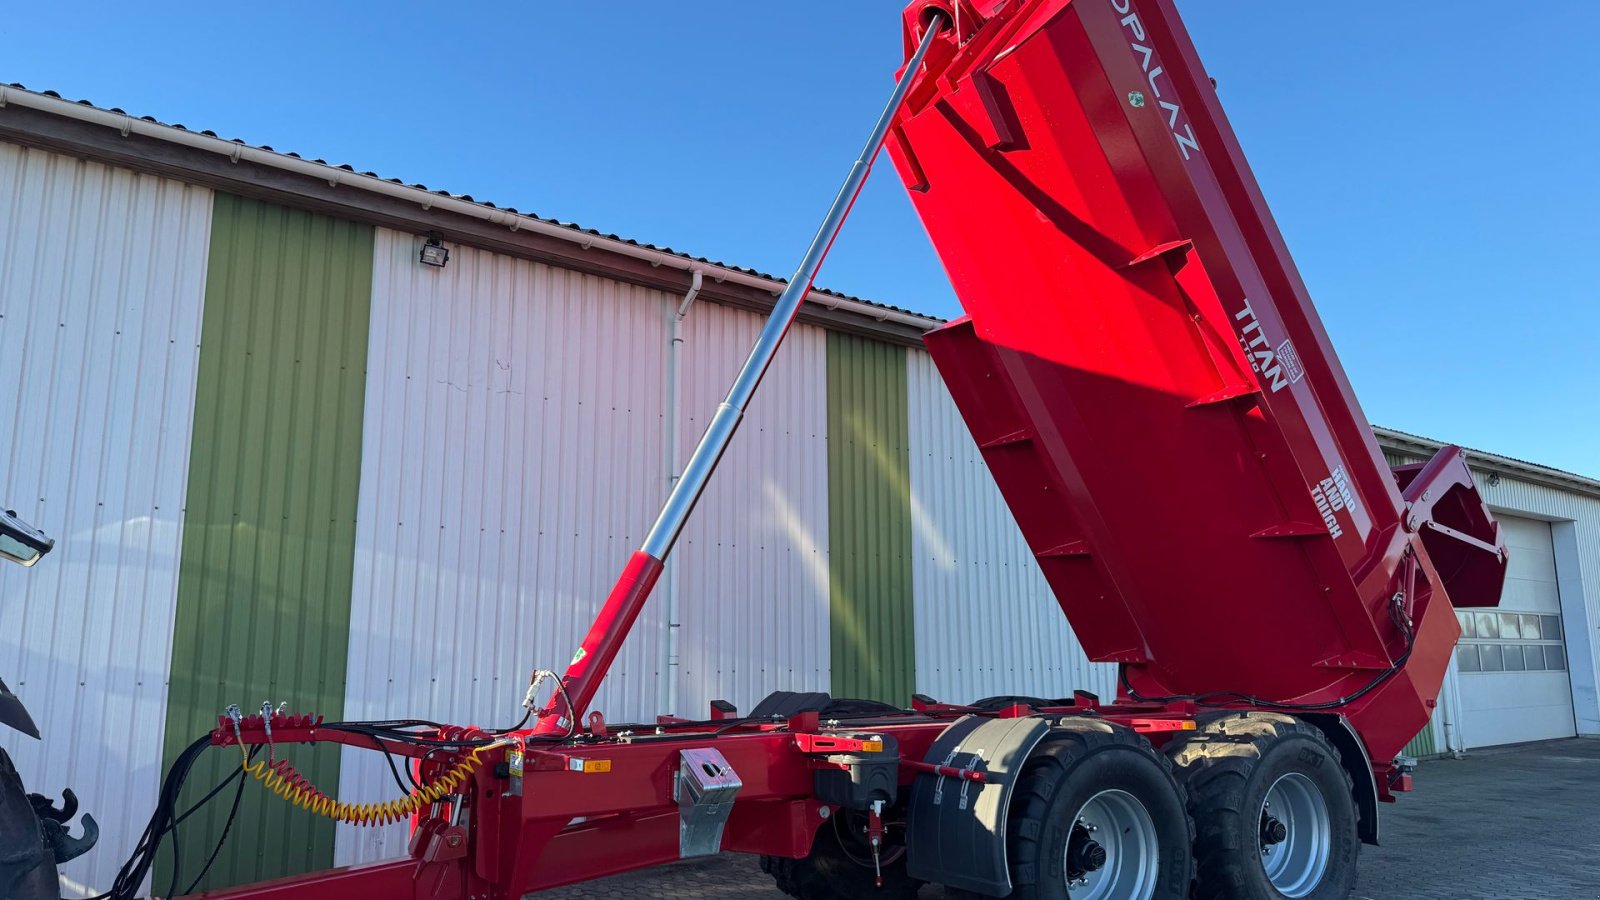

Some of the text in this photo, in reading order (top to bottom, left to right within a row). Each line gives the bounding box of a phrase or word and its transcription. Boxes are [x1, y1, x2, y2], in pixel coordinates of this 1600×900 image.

[1235, 298, 1288, 393] TITAN
[1311, 484, 1343, 539] TOUGH
[1320, 476, 1345, 512] AND
[1331, 468, 1356, 513] HARD
